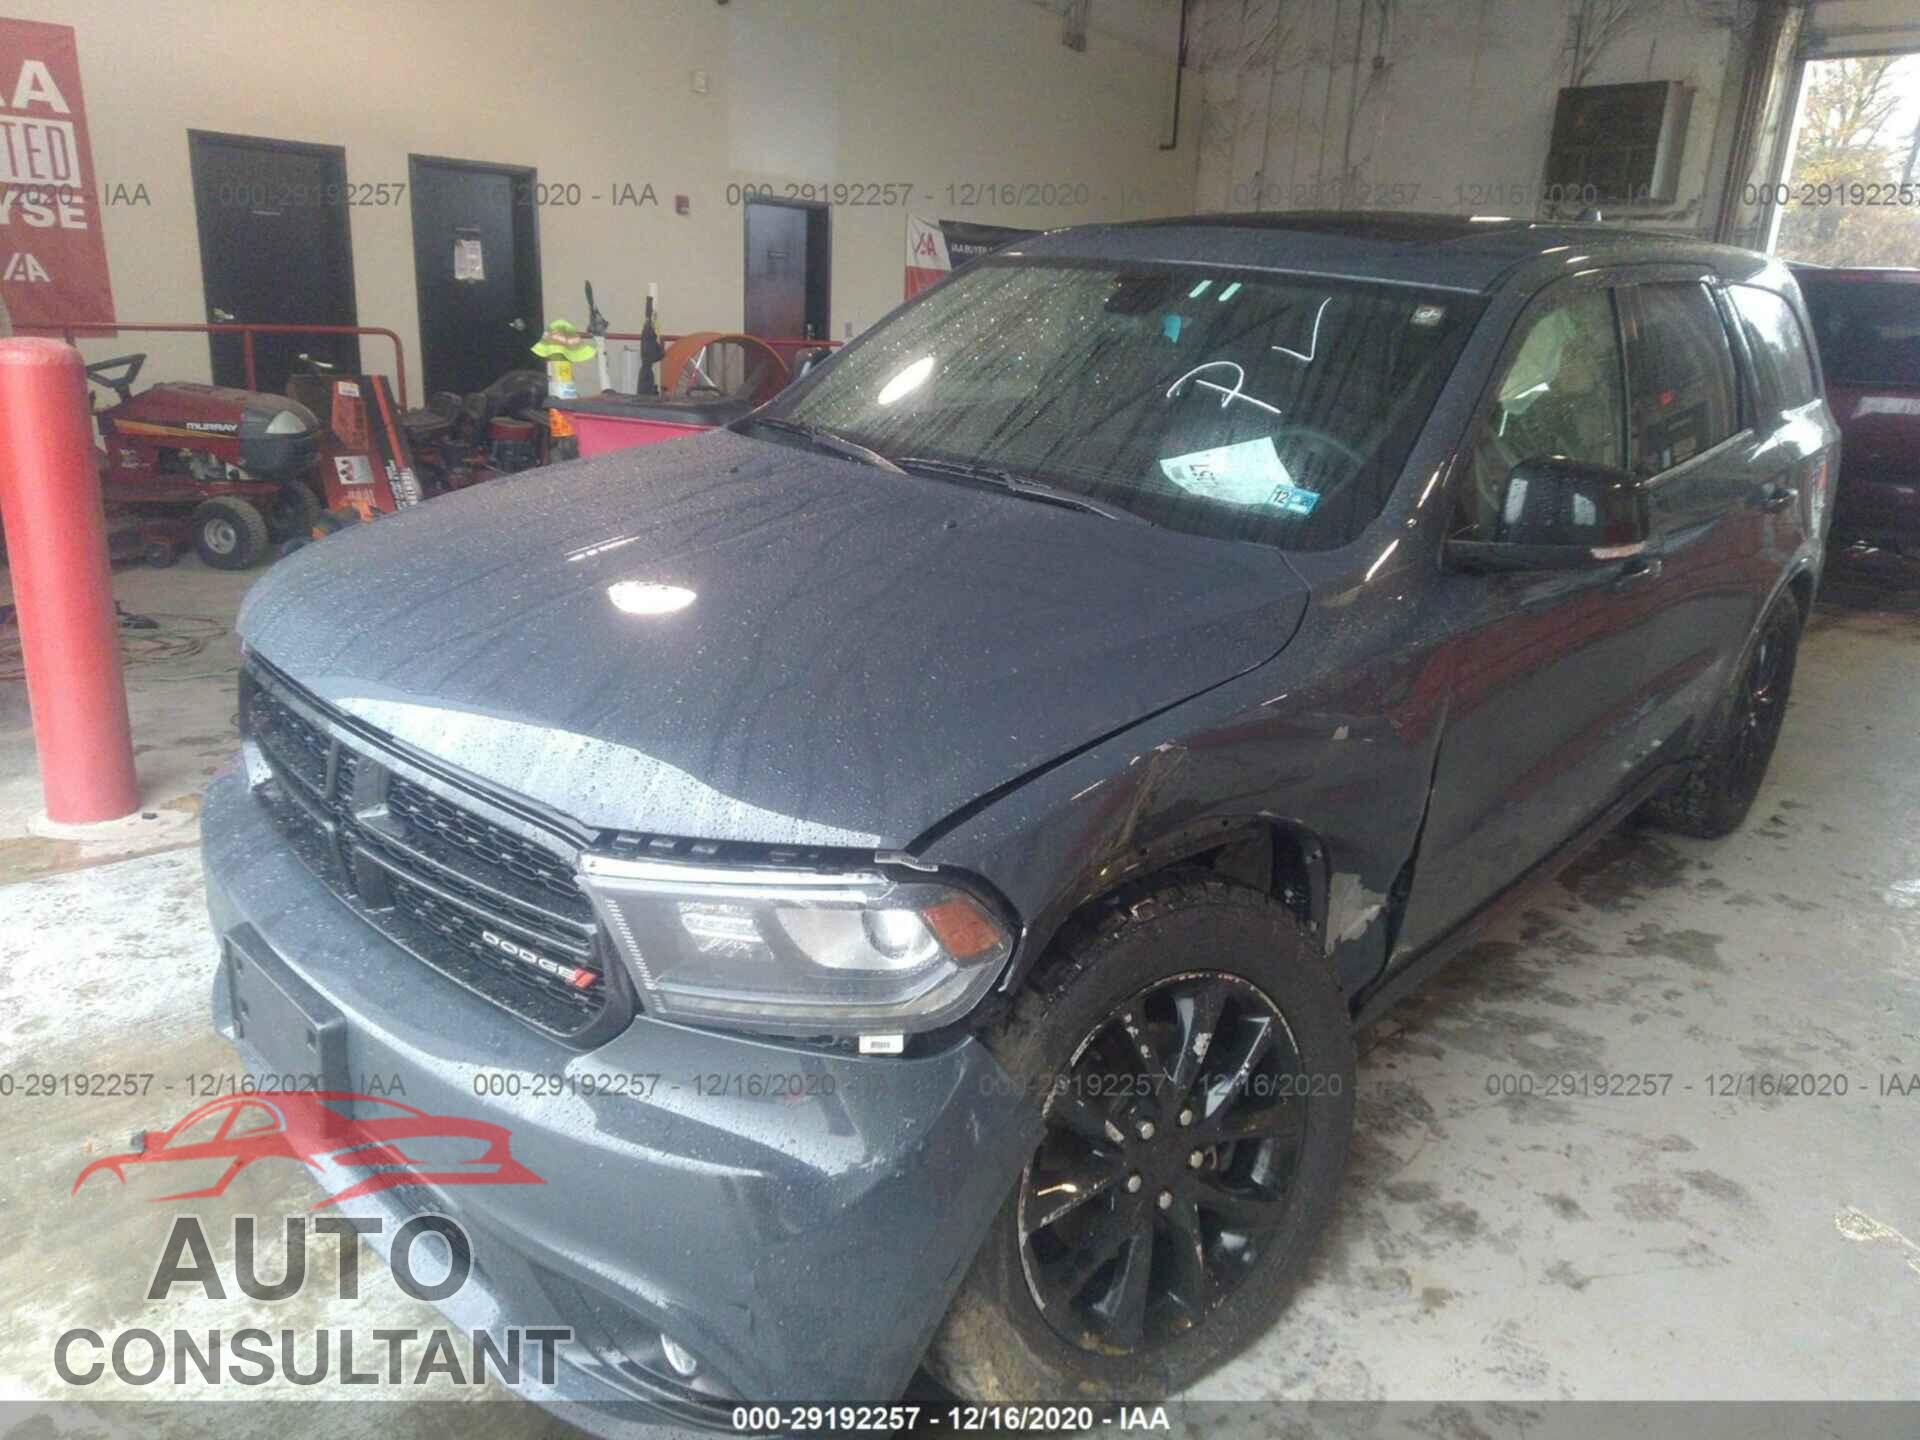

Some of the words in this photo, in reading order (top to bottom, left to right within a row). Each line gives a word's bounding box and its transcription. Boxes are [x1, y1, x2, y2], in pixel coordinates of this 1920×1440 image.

[0, 59, 71, 115] A
[186, 421, 238, 433] MURRAY
[482, 930, 578, 984] DODGE
